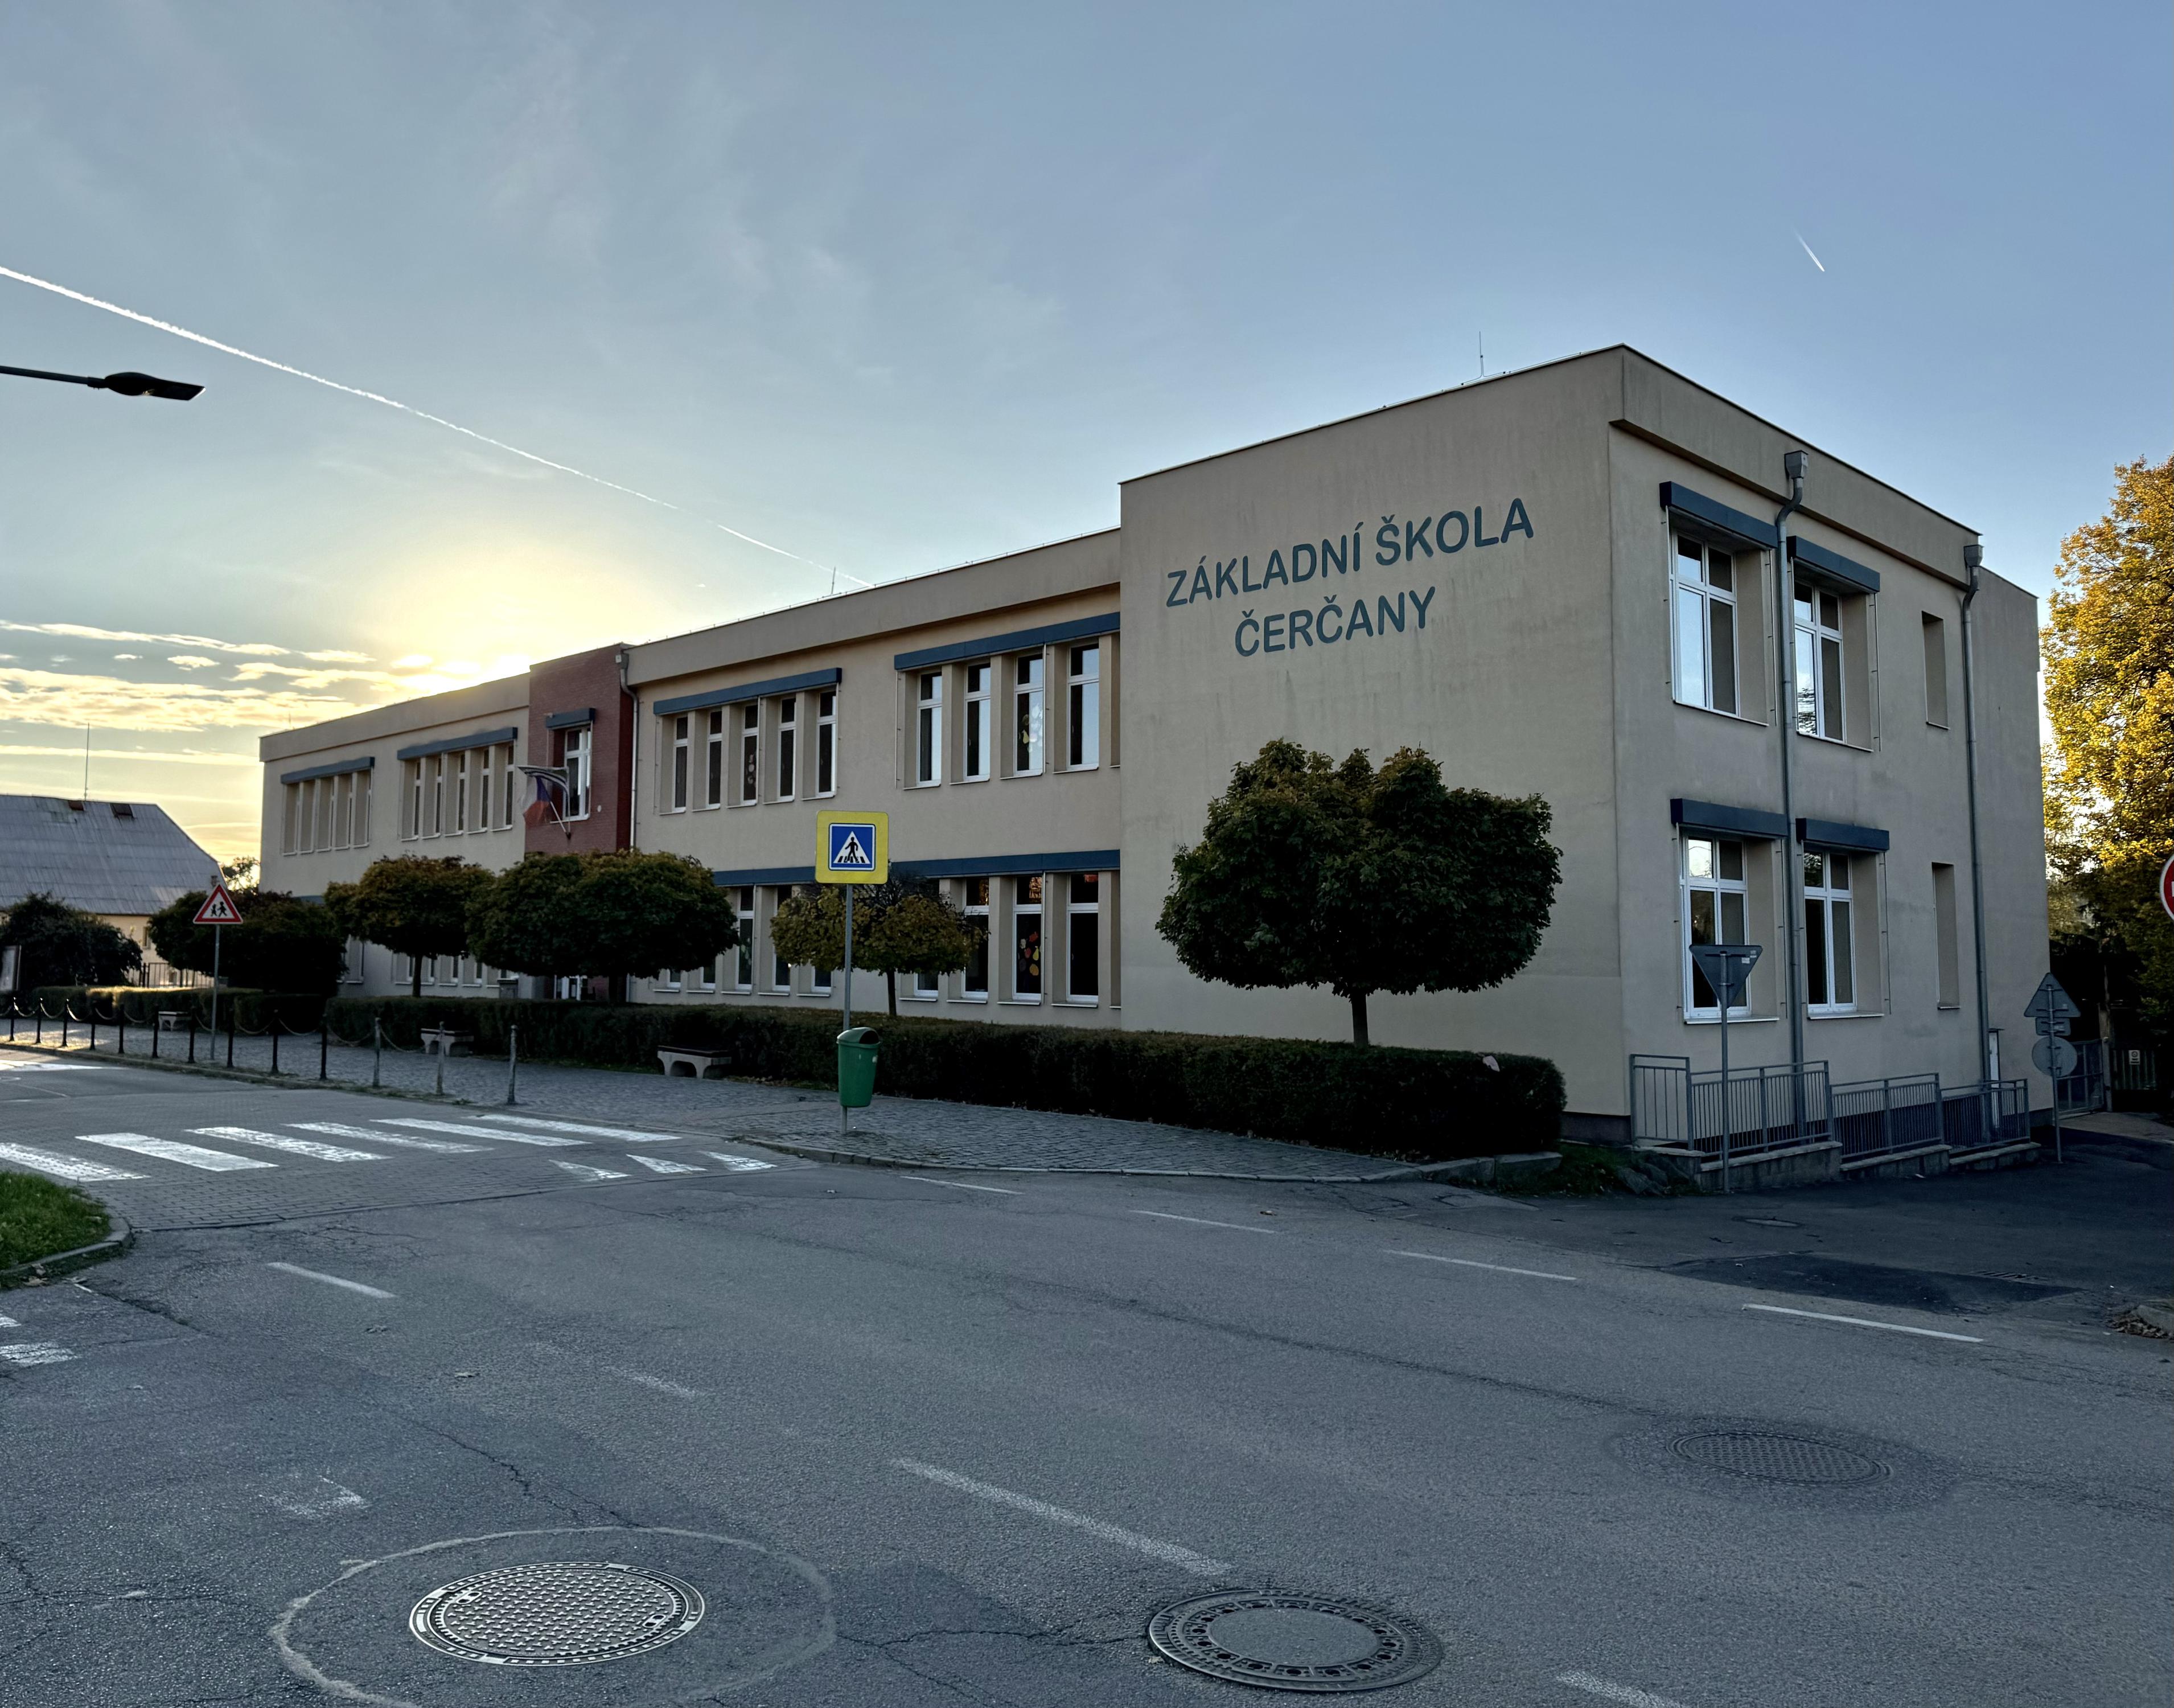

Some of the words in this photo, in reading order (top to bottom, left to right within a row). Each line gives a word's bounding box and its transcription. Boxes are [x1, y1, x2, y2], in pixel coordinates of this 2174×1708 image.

[1166, 521, 1364, 607] ZÁKLADNÍ
[1375, 498, 1534, 566] ŠKOLA
[1235, 586, 1436, 657] ČERČANY
